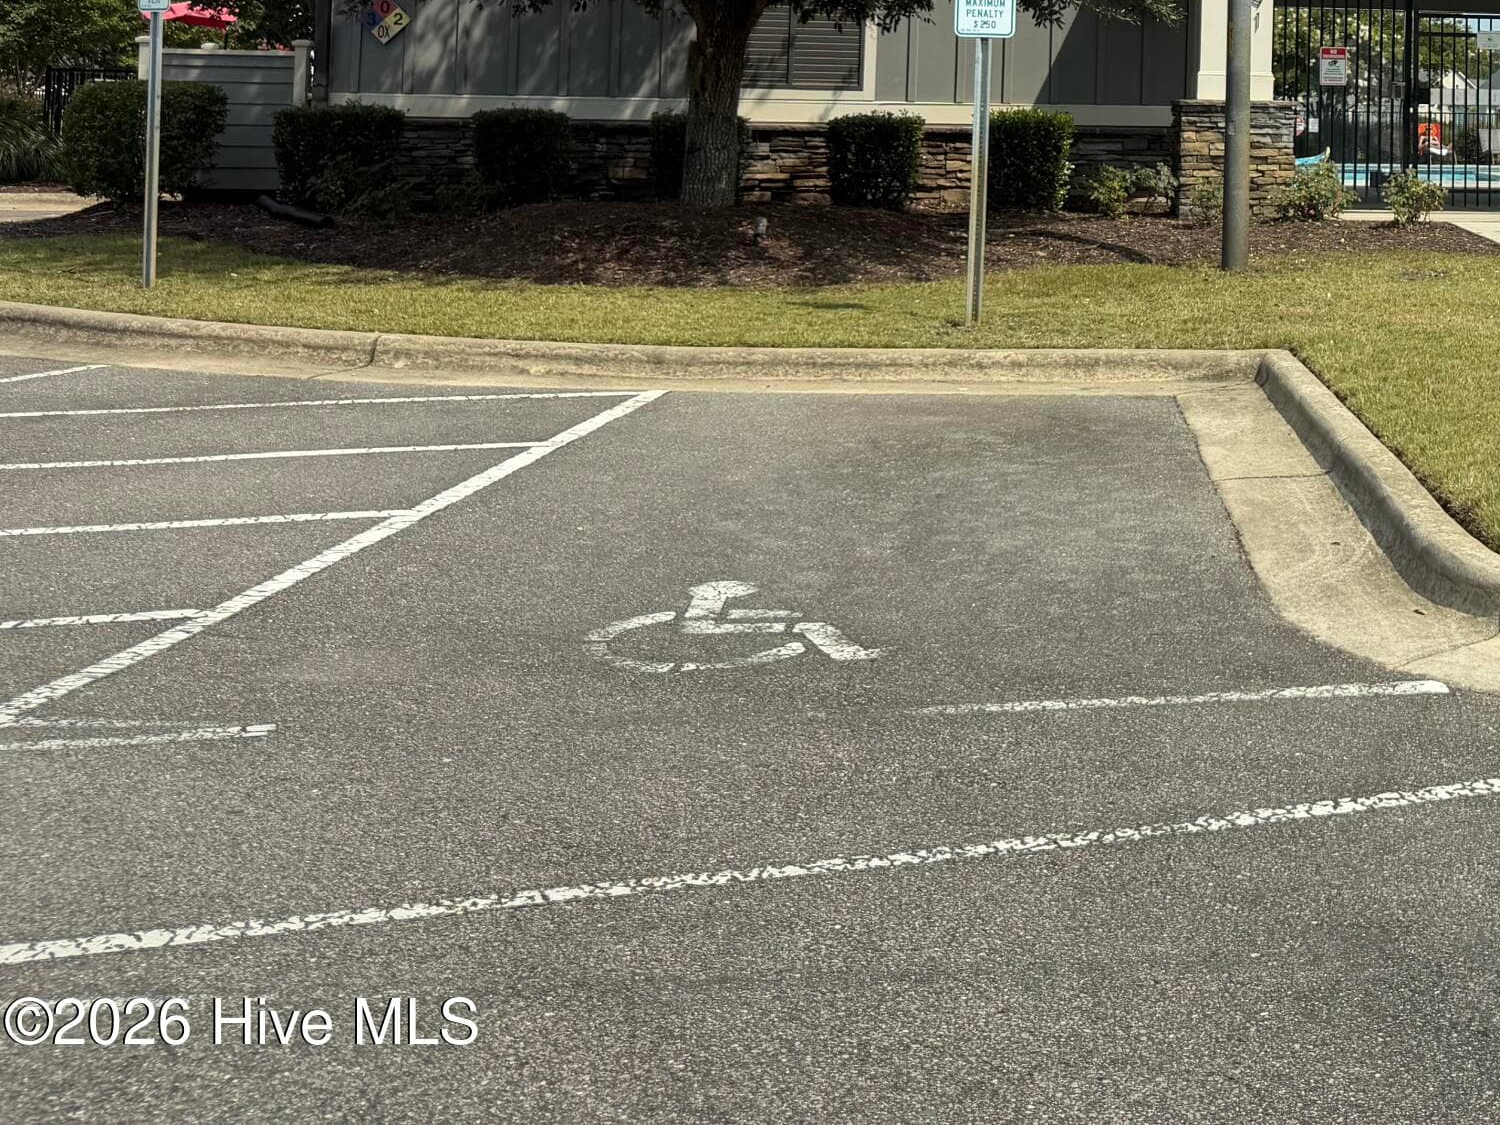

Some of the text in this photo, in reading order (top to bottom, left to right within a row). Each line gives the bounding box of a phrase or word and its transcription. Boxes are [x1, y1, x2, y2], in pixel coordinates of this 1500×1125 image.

[381, 0, 390, 14] 0
[966, 9, 1003, 18] PENALTY
[367, 11, 377, 26] 3
[393, 12, 403, 26] 2
[378, 25, 390, 38] OX
